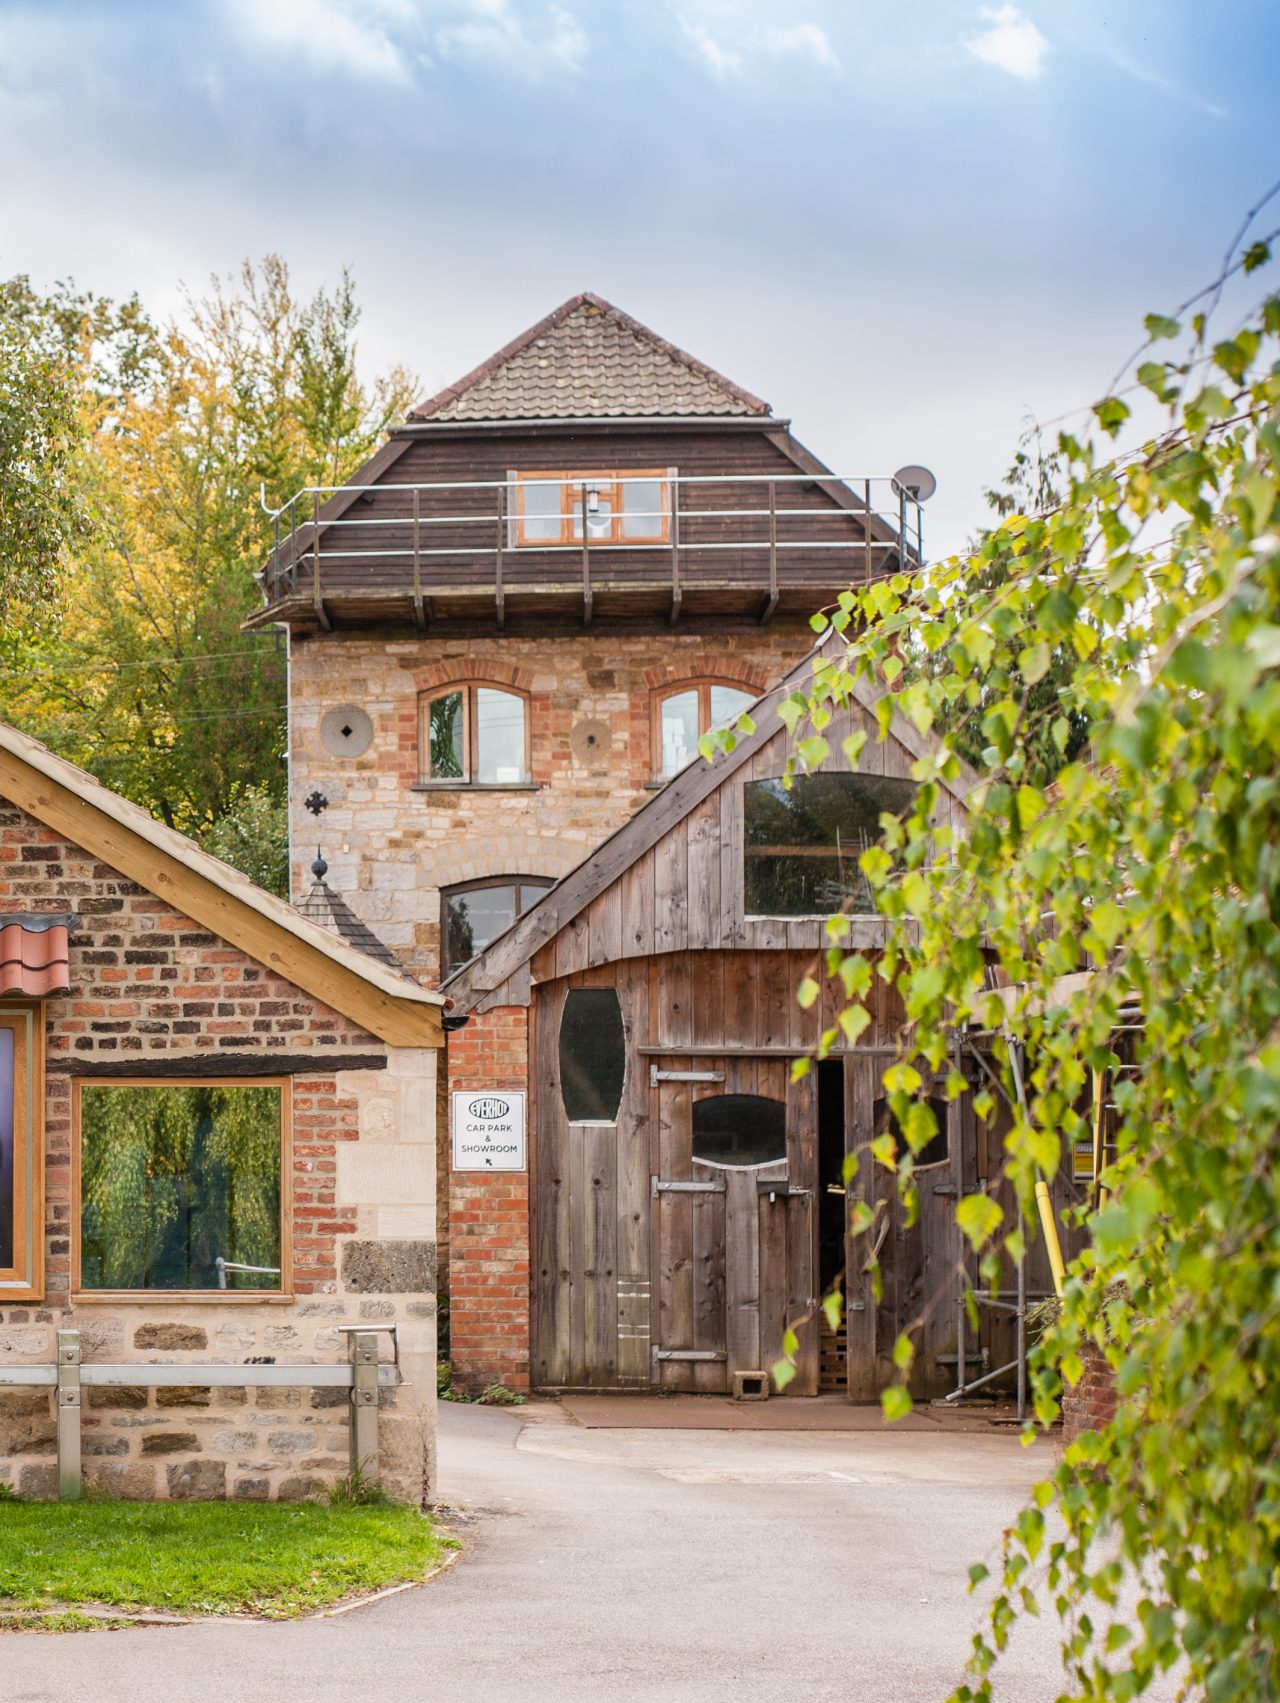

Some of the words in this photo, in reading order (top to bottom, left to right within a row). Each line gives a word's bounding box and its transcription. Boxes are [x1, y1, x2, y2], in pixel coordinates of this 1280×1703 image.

[466, 1124, 485, 1132] CAR
[488, 1124, 512, 1132] PARK
[461, 1145, 518, 1153] SHOWROOM
